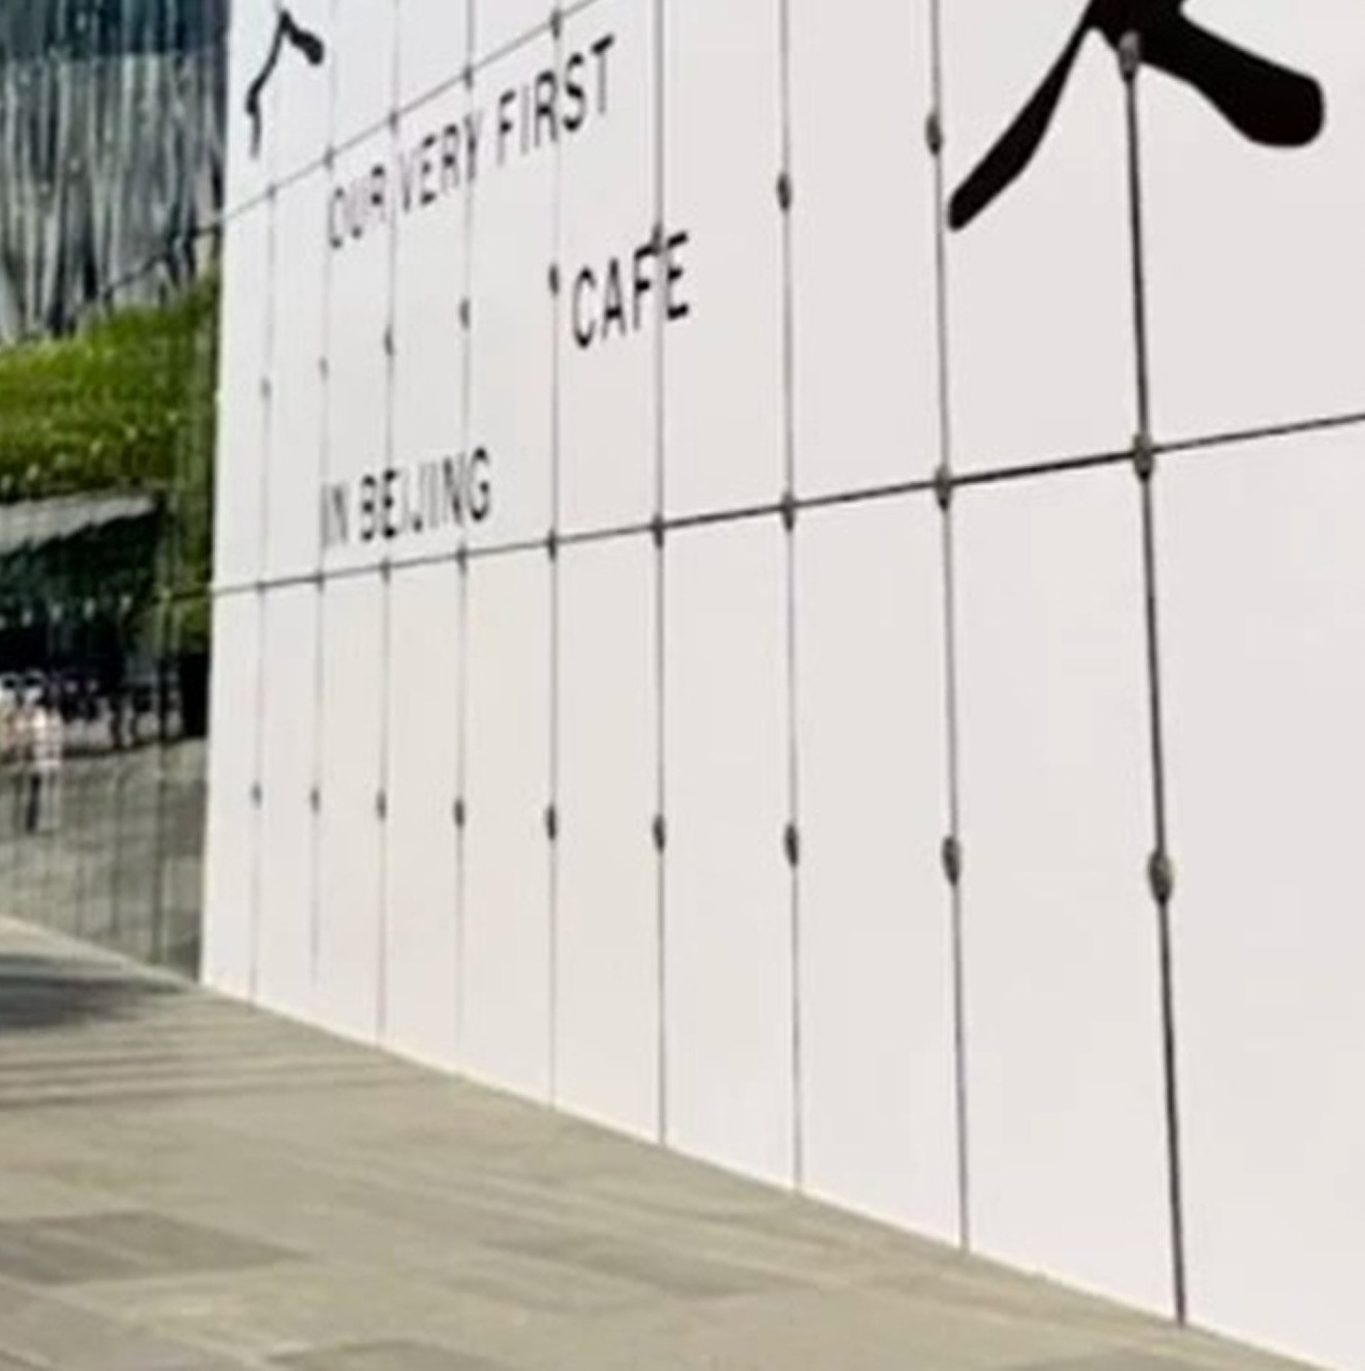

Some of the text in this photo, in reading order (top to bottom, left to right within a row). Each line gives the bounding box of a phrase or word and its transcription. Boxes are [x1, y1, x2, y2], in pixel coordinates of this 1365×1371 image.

[328, 34, 614, 250] OUR VERY FIRST
[572, 232, 689, 349] CAFE
[320, 446, 492, 549] IN BEIJING
